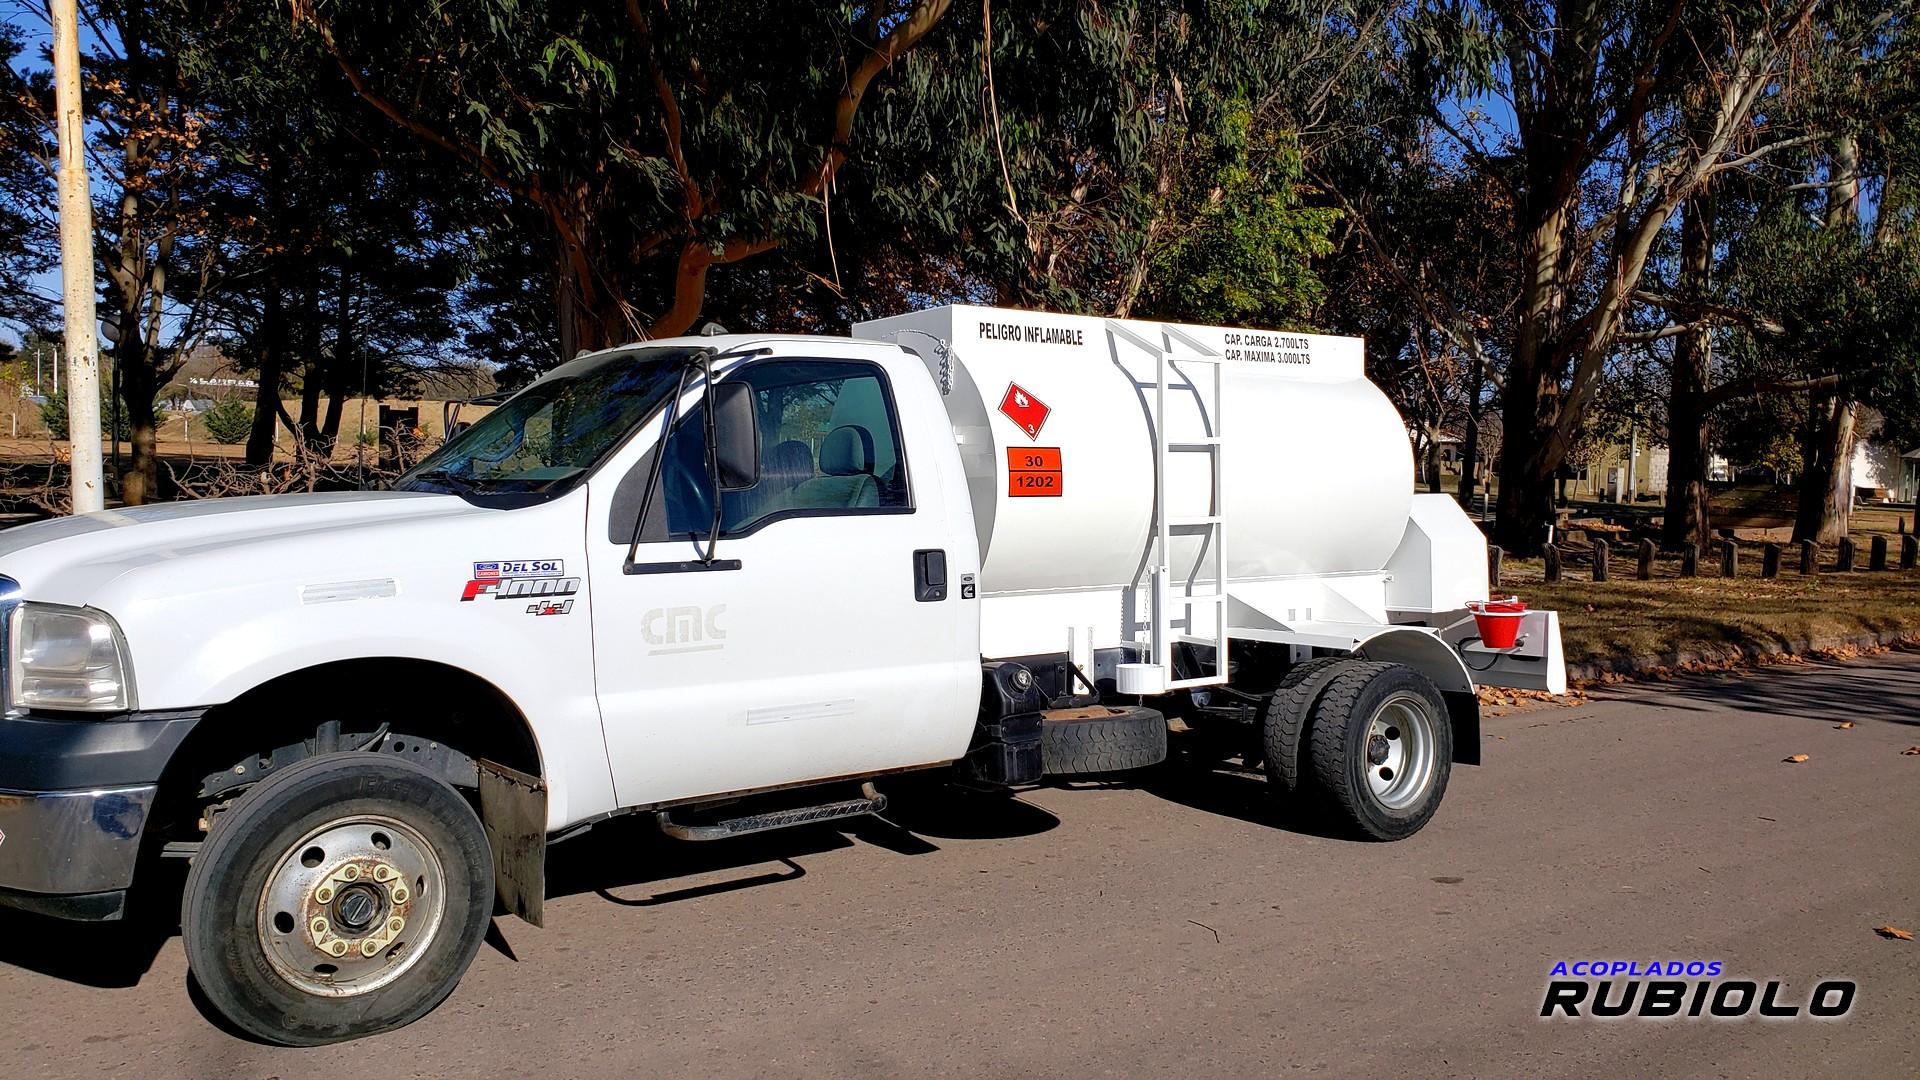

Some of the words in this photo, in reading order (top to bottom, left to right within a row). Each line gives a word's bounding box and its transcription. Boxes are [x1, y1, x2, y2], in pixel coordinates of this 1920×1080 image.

[979, 321, 1021, 342] PELIGRO
[1024, 325, 1083, 346] INFLAMABLE
[1224, 333, 1242, 346] CAP.
[1244, 334, 1273, 348] CARGA
[1274, 336, 1309, 350] 2.700LTS
[1225, 348, 1242, 361] CAP.
[1244, 349, 1276, 363] MAXIMA
[1277, 351, 1311, 365] 3.000LTS
[1028, 423, 1036, 435] 3
[1024, 455, 1044, 467] 30
[1016, 475, 1054, 488] 1202
[502, 562, 528, 572] DEL
[531, 561, 558, 571] SOL
[460, 577, 581, 602] F4000
